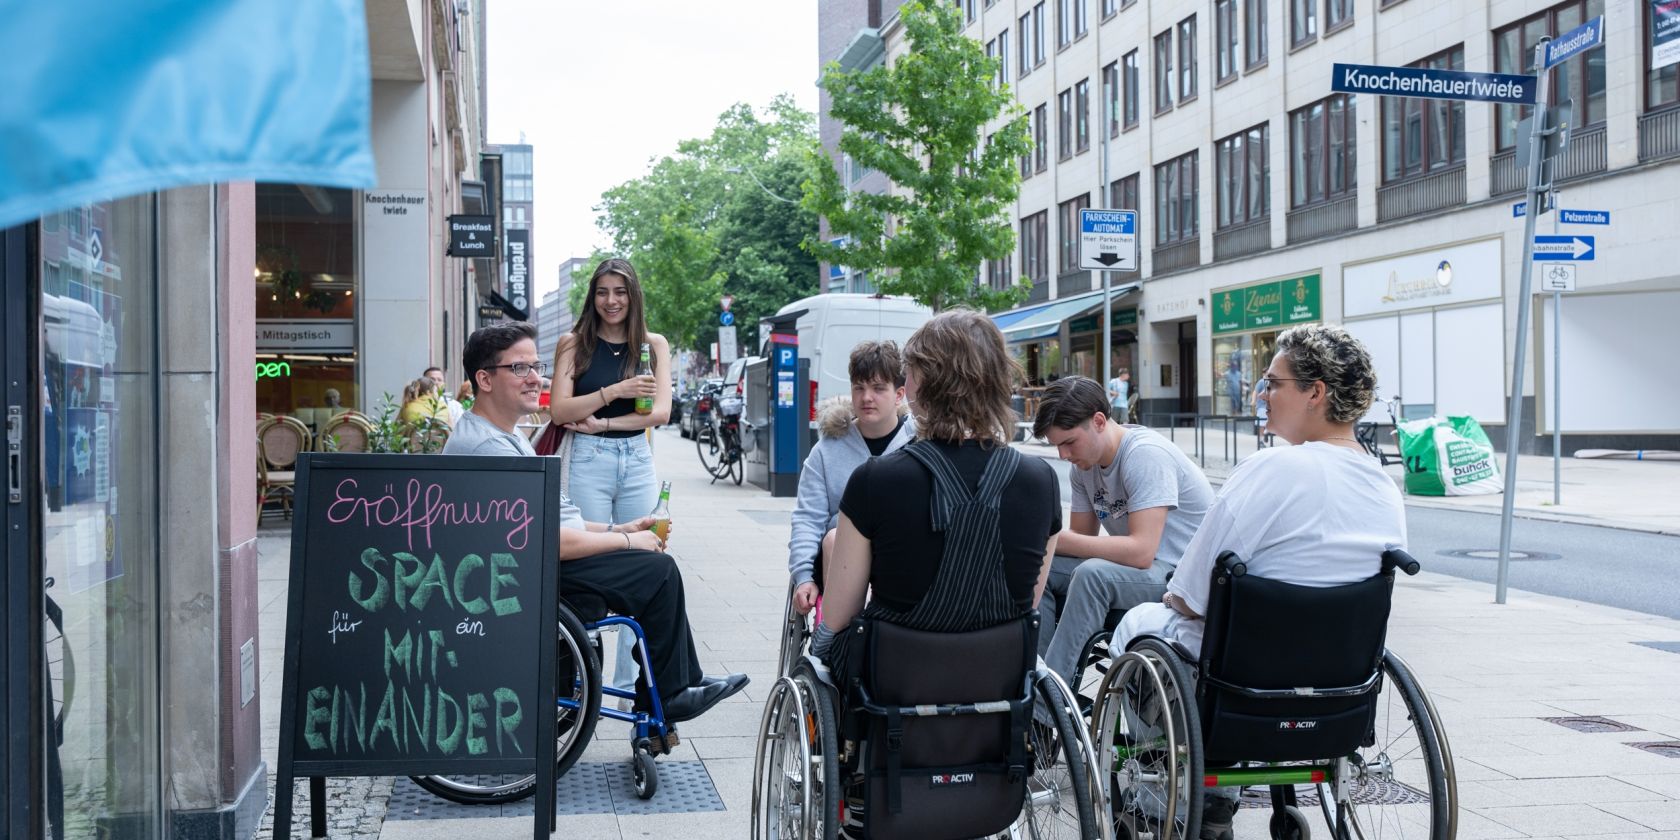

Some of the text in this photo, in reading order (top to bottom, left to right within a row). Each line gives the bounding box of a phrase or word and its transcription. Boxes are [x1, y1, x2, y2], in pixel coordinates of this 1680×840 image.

[1550, 26, 1595, 61] Rathausstraße
[1344, 68, 1524, 98] Knochenhauertwiete
[365, 193, 425, 204] Knochenhauer
[383, 206, 408, 215] twiete
[1085, 212, 1131, 223] PARKSCHEIN-
[1564, 212, 1606, 223] Pelzerstraße
[453, 223, 492, 231] Breakfast
[1093, 223, 1124, 233] AUTOMAT
[468, 232, 476, 240] &
[459, 241, 485, 249] Lunch
[509, 242, 527, 295] prediger
[262, 330, 331, 342] Mittagstisch
[781, 350, 792, 364] P
[256, 361, 291, 381] pen
[1453, 459, 1490, 475] buhck
[327, 478, 534, 551] Eröffnung
[348, 547, 523, 616] SPACE
[328, 610, 486, 644] für ein
[304, 678, 524, 757] EINANDER
[1279, 720, 1317, 729] PROACTIV
[932, 773, 974, 784] PROACTIV
